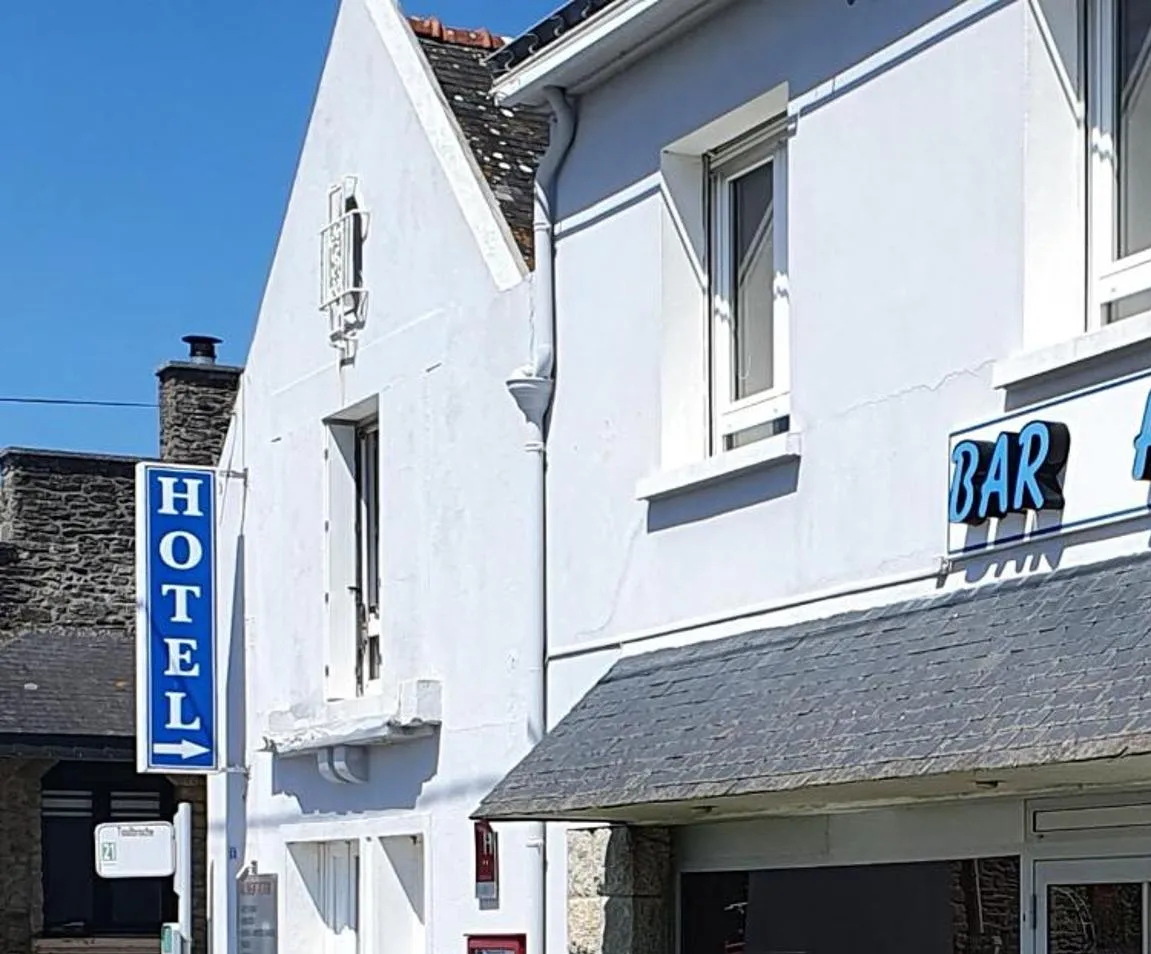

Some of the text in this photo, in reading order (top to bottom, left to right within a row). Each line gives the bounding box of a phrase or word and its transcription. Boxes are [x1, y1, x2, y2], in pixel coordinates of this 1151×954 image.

[949, 419, 1066, 525] BAR
[156, 475, 204, 731] HOTEL
[103, 844, 115, 860] 21
